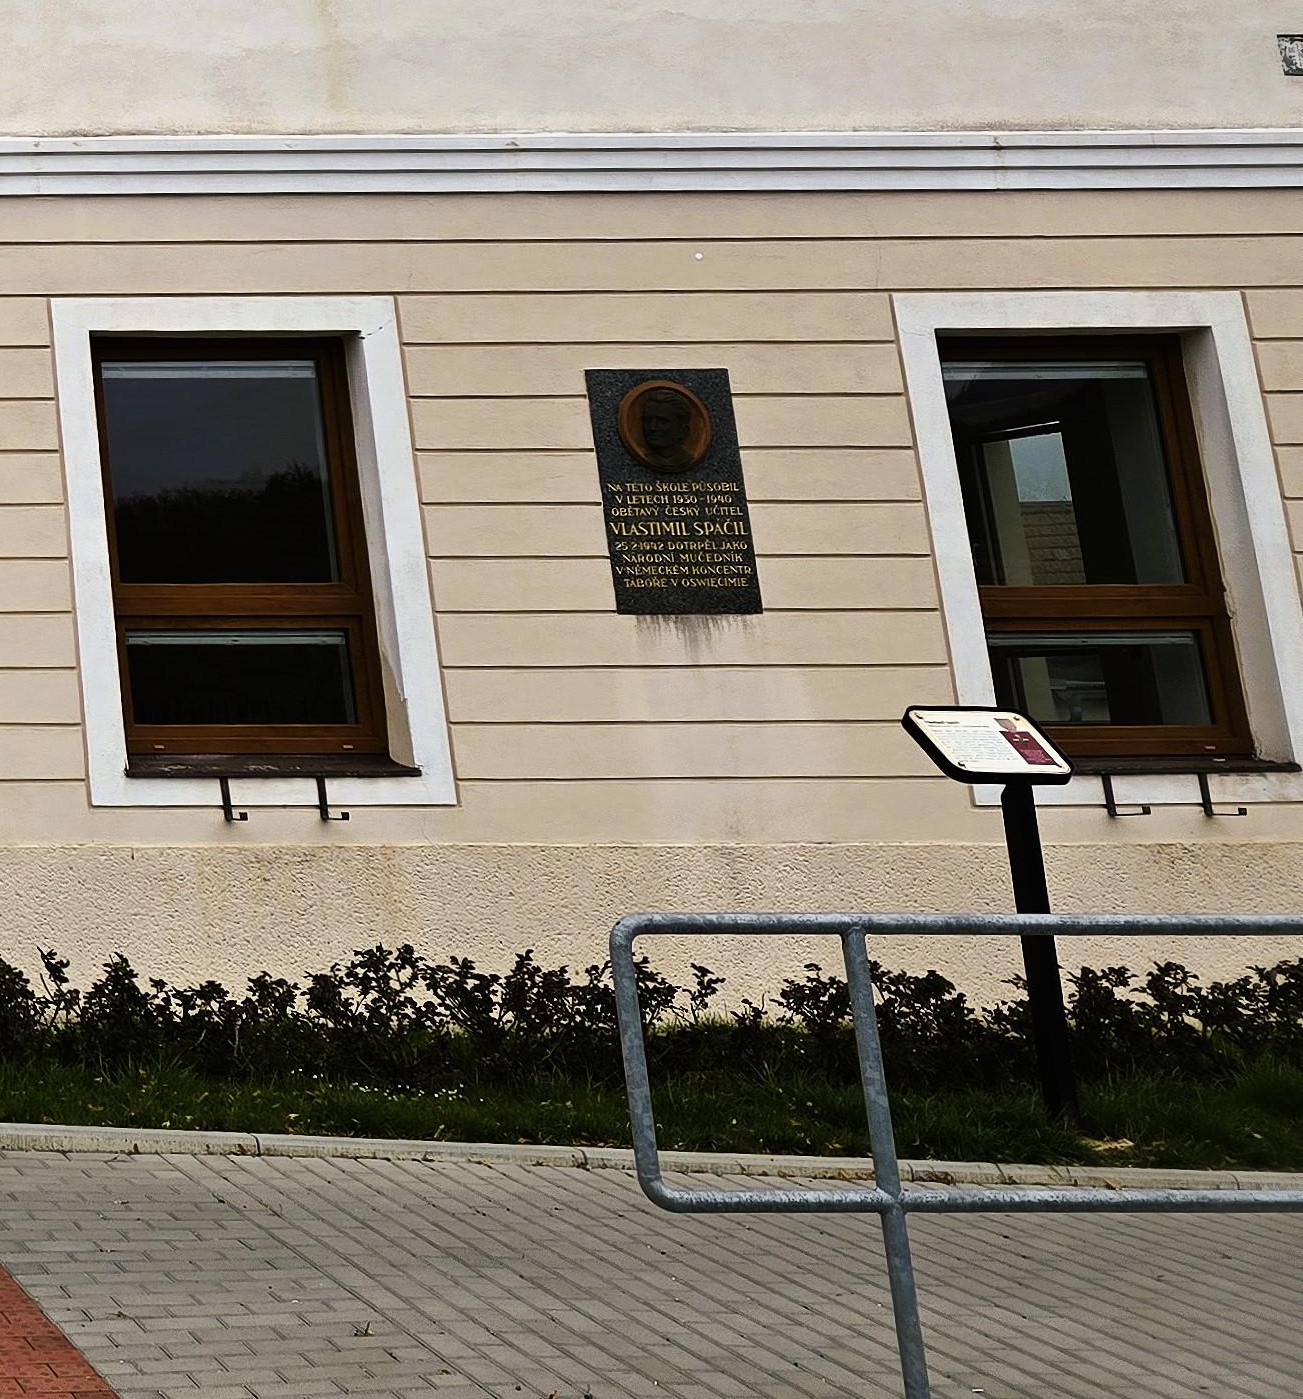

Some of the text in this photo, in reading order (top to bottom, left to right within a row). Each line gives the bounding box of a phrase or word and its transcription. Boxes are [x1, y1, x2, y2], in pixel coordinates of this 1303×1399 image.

[607, 483, 622, 492] NA
[655, 480, 689, 492] ŠKOLE
[692, 480, 739, 492] PŮSOBIL
[615, 495, 623, 504] V
[627, 495, 668, 504] LETECH
[665, 505, 700, 516] ČESKÝ
[705, 505, 743, 516] UČITEL
[609, 518, 749, 536] VLASTIMIL SPÁČIL
[668, 539, 718, 550] DOTRPĚL
[718, 541, 747, 550] JAKO
[679, 551, 743, 563] MUČEDNÍK
[615, 566, 624, 575] V
[671, 578, 680, 587] V
